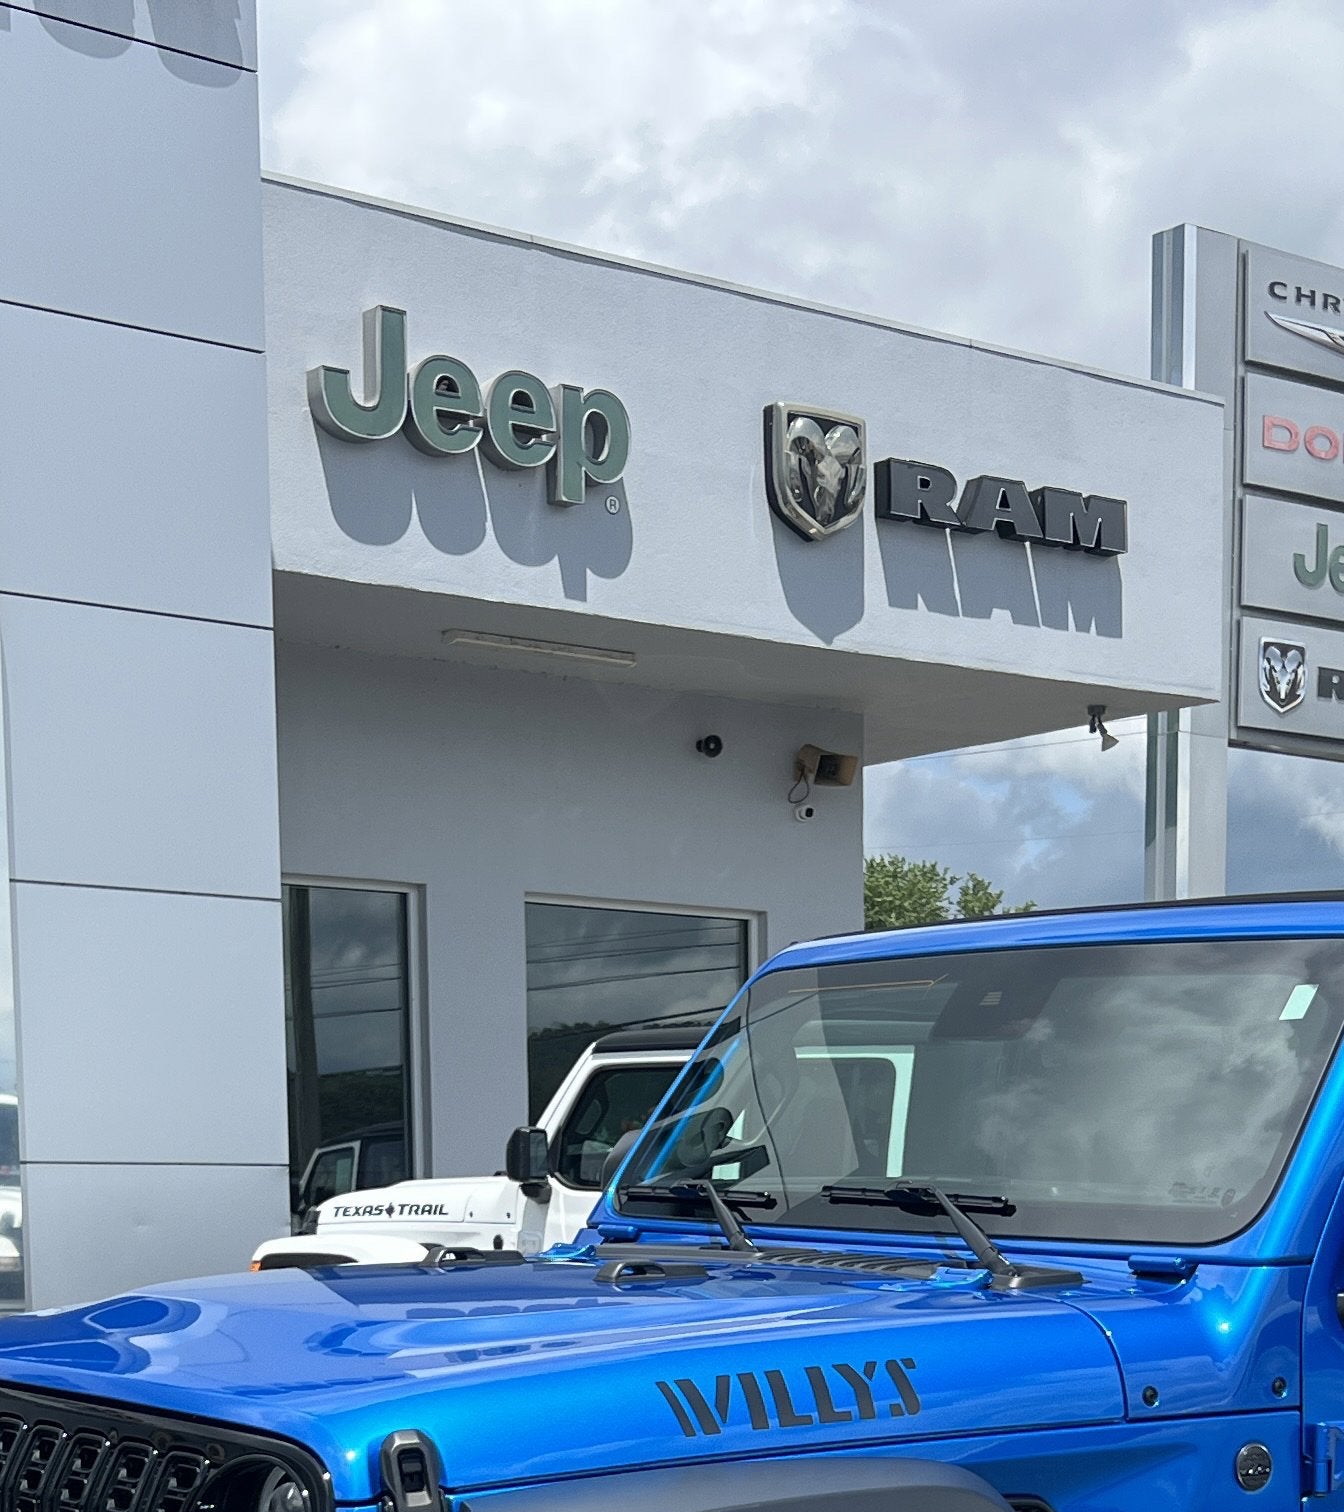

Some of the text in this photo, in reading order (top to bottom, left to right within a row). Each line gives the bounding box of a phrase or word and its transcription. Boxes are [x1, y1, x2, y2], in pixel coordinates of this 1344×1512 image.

[306, 304, 632, 507] Jeep
[874, 457, 1129, 557] RAM
[333, 1203, 449, 1218] TEXAS TRAIL
[655, 1357, 922, 1437] WILLYS
